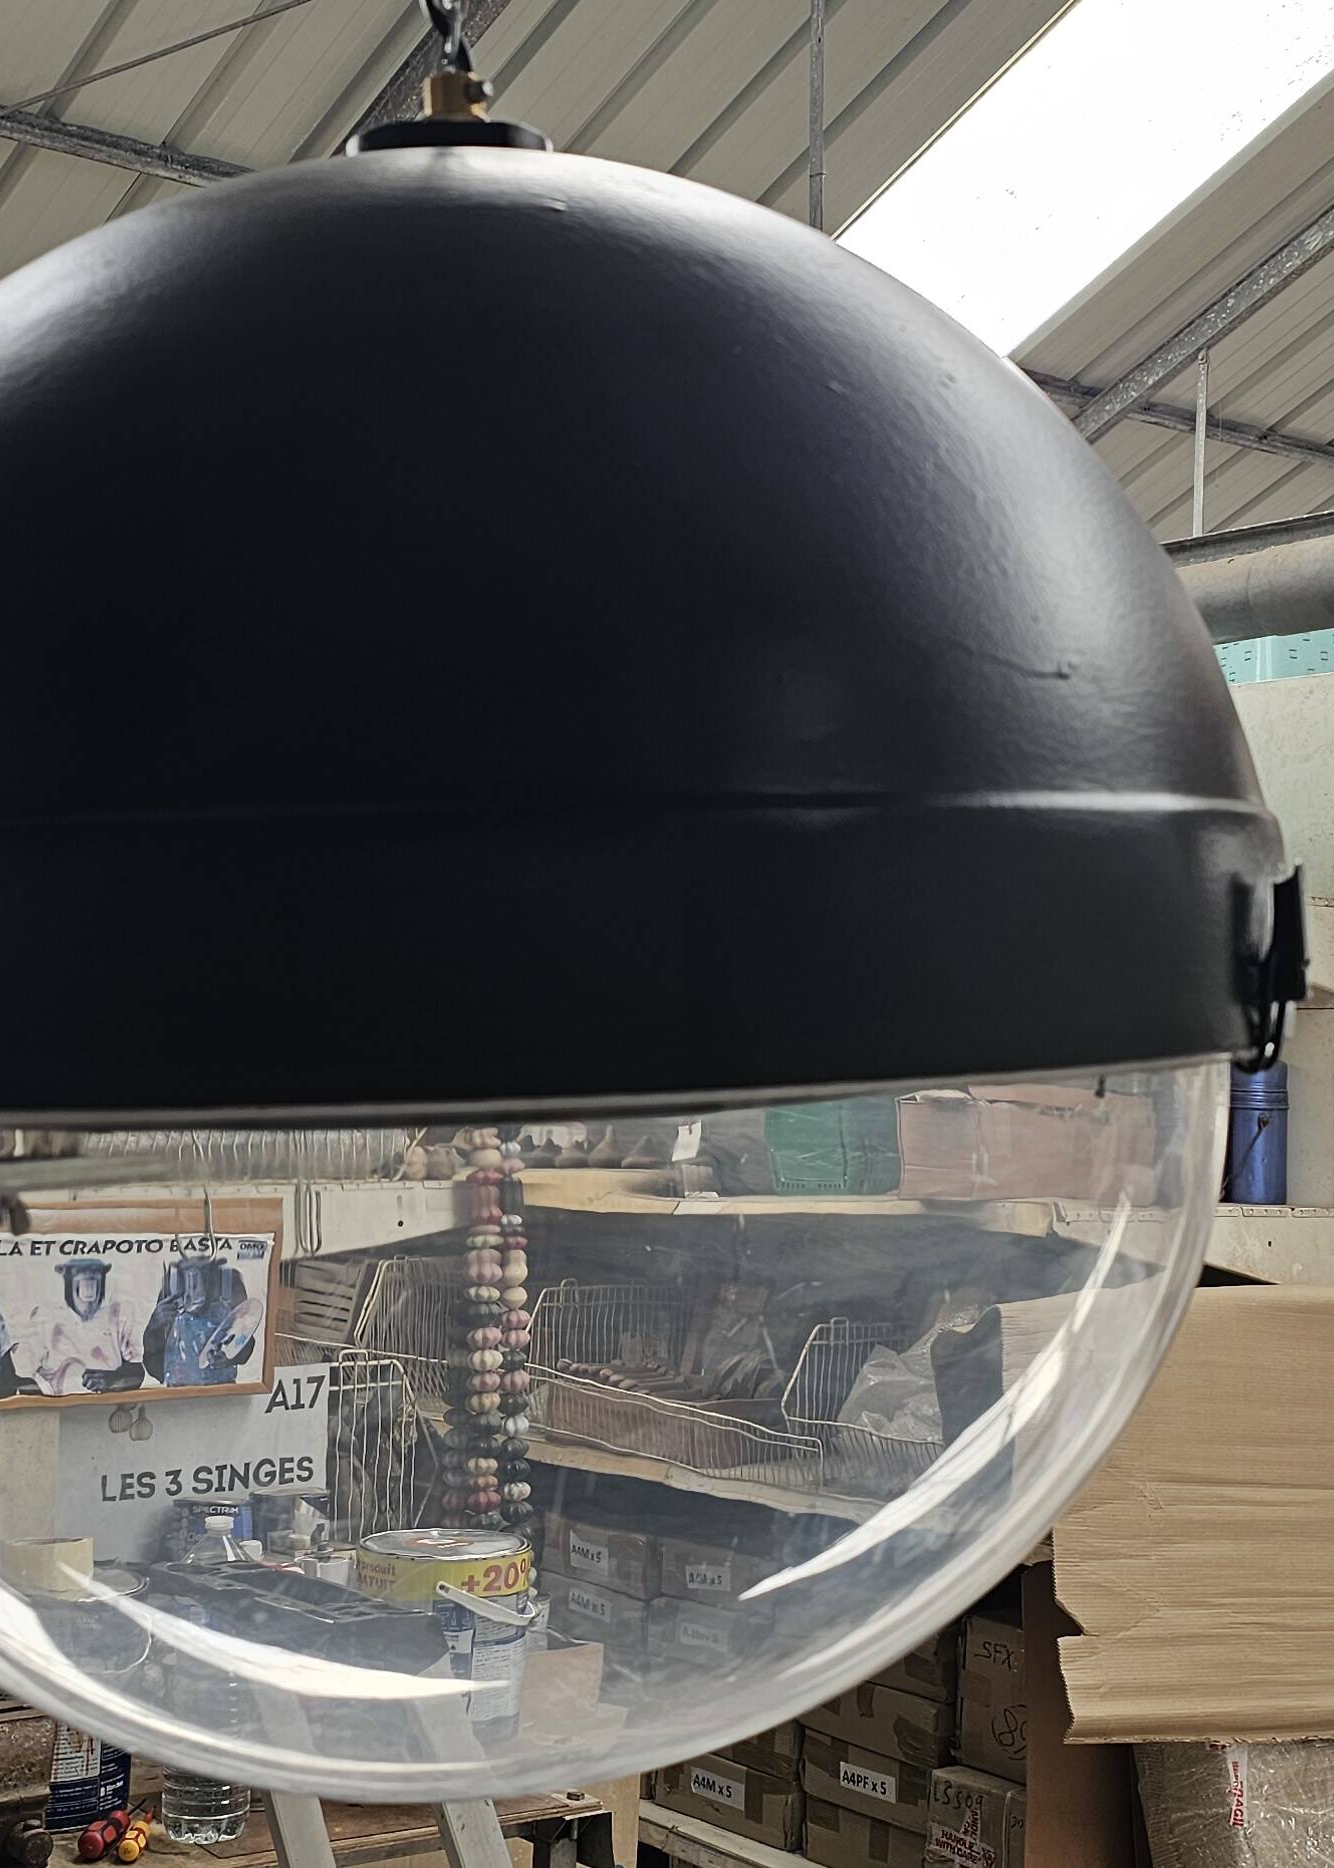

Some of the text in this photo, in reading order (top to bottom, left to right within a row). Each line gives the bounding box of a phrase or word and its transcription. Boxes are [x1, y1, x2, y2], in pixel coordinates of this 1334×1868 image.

[30, 1240, 57, 1256] ET
[58, 1239, 164, 1256] CRAPOTO
[264, 1375, 326, 1414] A17
[101, 1456, 315, 1502] LES 3 SINGES
[693, 1774, 732, 1798] A4M x 5
[842, 1769, 887, 1795] A4PF x 5
